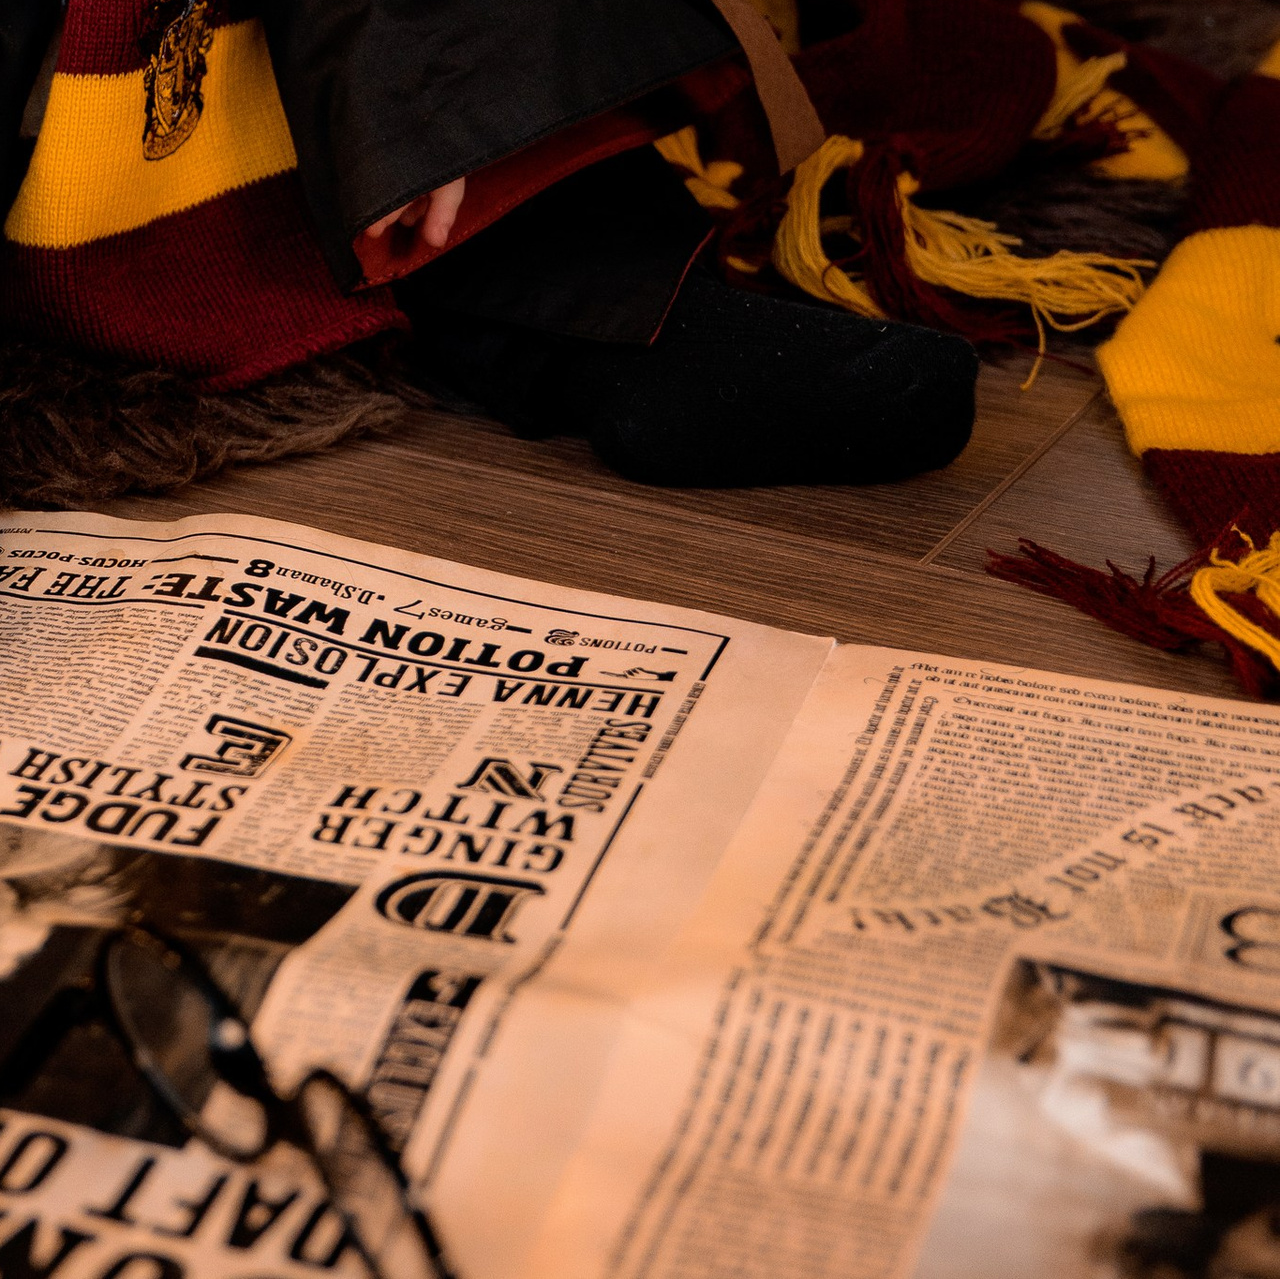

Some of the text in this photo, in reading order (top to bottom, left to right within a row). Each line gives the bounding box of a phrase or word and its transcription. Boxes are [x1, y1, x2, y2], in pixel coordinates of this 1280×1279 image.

[6, 549, 149, 569] HOCUS-POCUS
[43, 572, 133, 600] THE
[140, 573, 352, 637] WASTE:
[428, 607, 509, 632] games
[203, 615, 473, 698] EXPLOSION
[357, 617, 591, 679] POTION
[578, 637, 658, 655] POTIONS
[491, 679, 662, 719] HENNA
[7, 747, 249, 812] STYLISH
[557, 718, 653, 814] SURVIVES
[310, 813, 565, 874] GINGER
[327, 785, 578, 842] WITCH
[82, 1156, 351, 1270] DAFT
